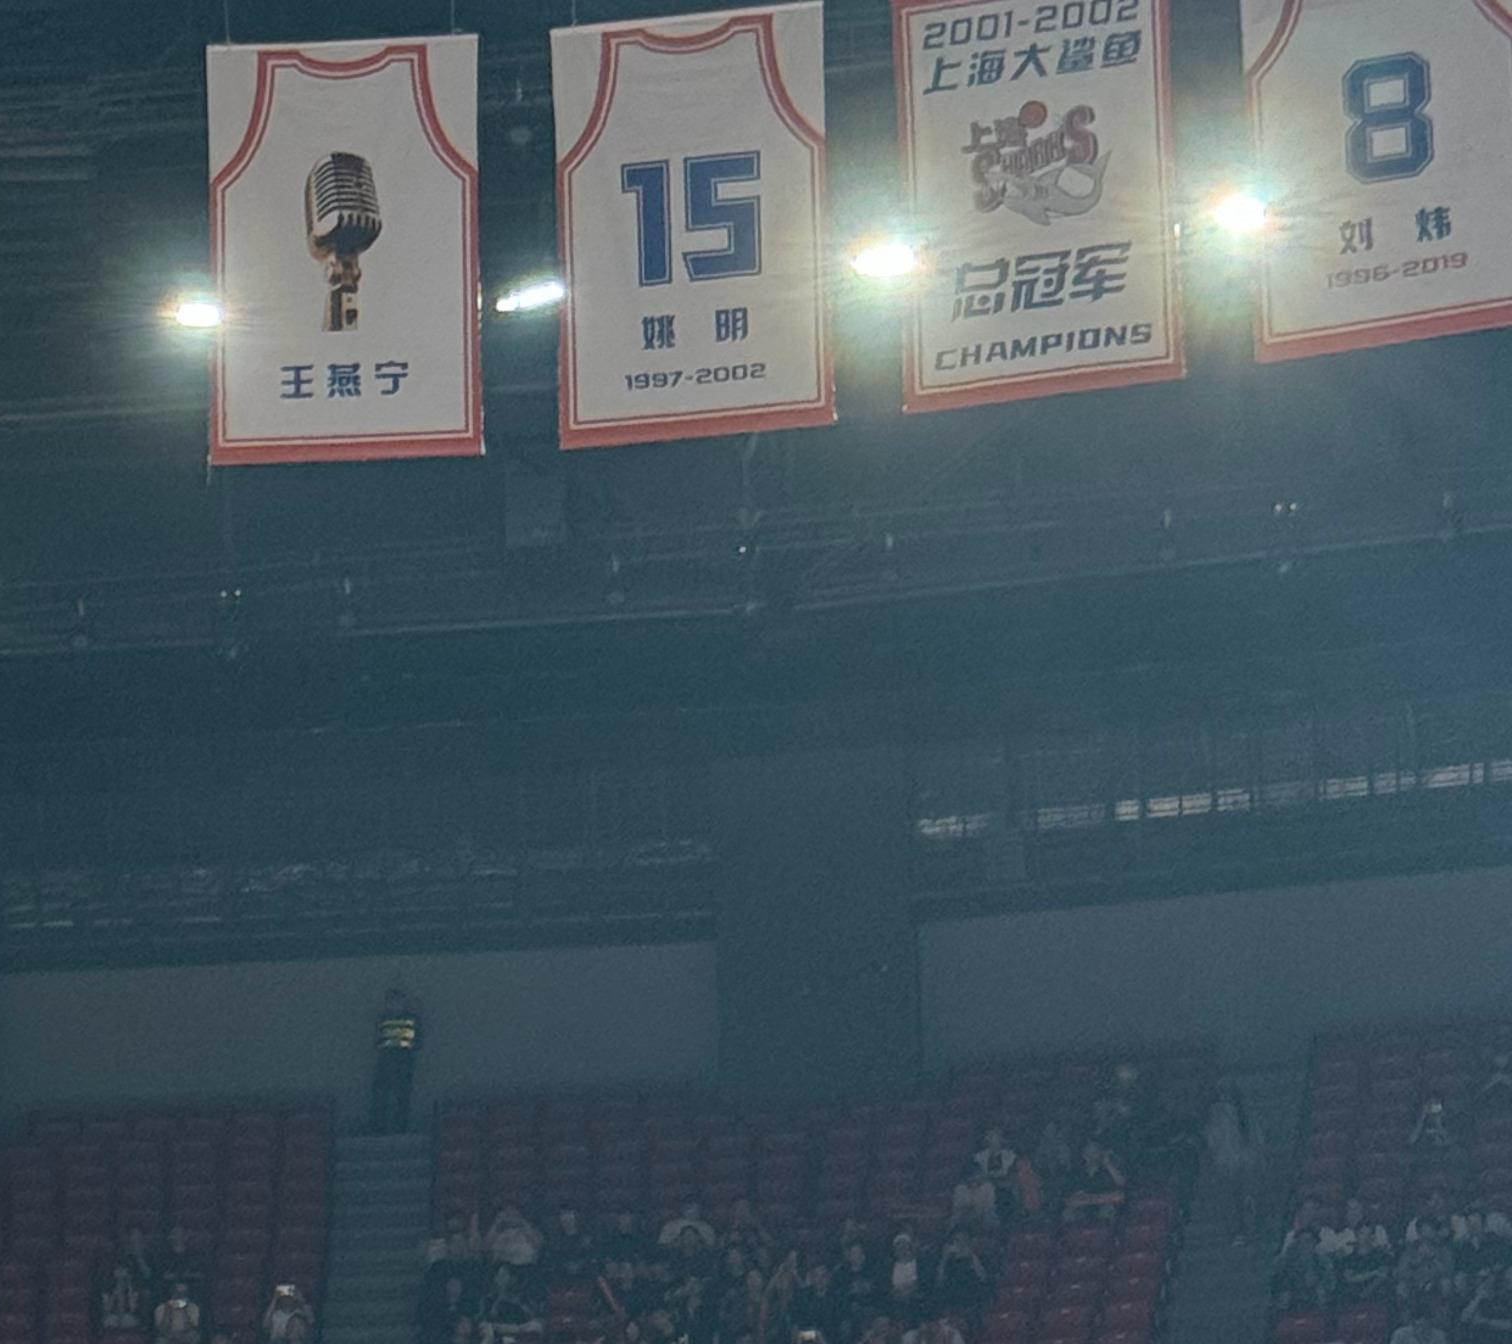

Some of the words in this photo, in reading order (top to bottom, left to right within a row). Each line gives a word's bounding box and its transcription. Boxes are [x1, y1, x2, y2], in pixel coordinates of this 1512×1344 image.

[922, 0, 1141, 50] 2001-2002
[922, 29, 1142, 95] 上海大鲨鱼
[1342, 51, 1435, 184] 8
[621, 150, 762, 287] 15
[951, 241, 1133, 321] 总冠军
[1327, 251, 1469, 289] 1996-2019
[642, 307, 749, 350] 姚明
[934, 323, 1152, 371] CHAMPIONS
[280, 361, 409, 399] 王燕宁
[625, 362, 767, 391] 1997-2002
